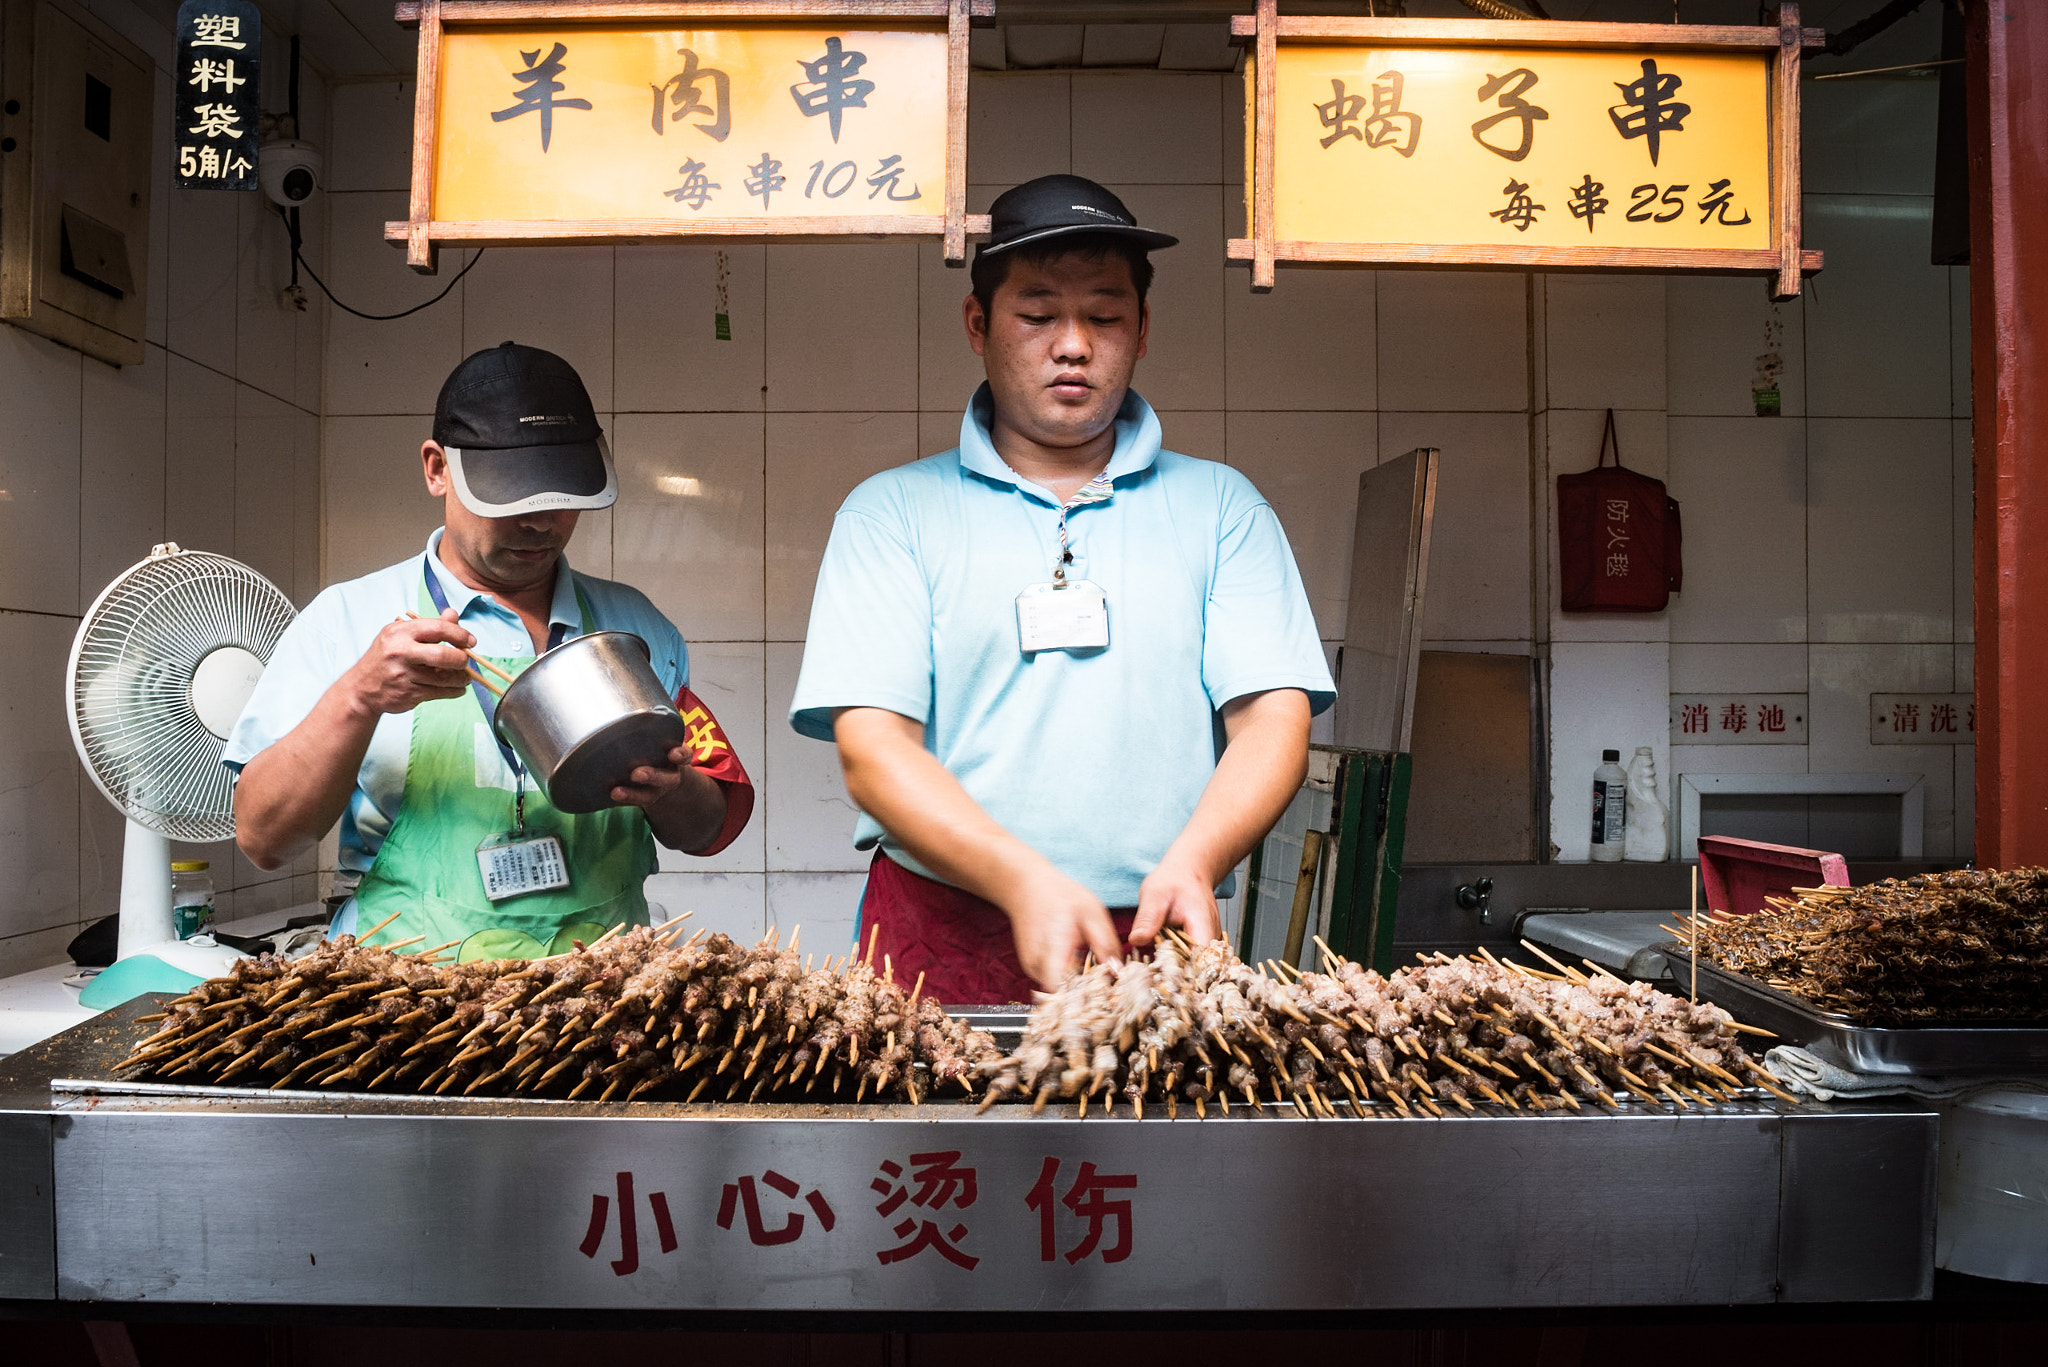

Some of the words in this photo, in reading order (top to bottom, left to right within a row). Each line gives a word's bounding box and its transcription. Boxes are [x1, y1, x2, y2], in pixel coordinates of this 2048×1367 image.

[188, 13, 247, 139] 塑料袋
[490, 36, 876, 154] 羊肉串
[1313, 58, 1692, 168] 蝎子串
[180, 145, 253, 179] 5角/个
[663, 152, 922, 212] 每串10元
[1488, 173, 1752, 234] 每串25元
[1606, 499, 1630, 577] 防火毯
[1681, 702, 1786, 734] 消毒池
[578, 1150, 1138, 1277] 小心烫伤
